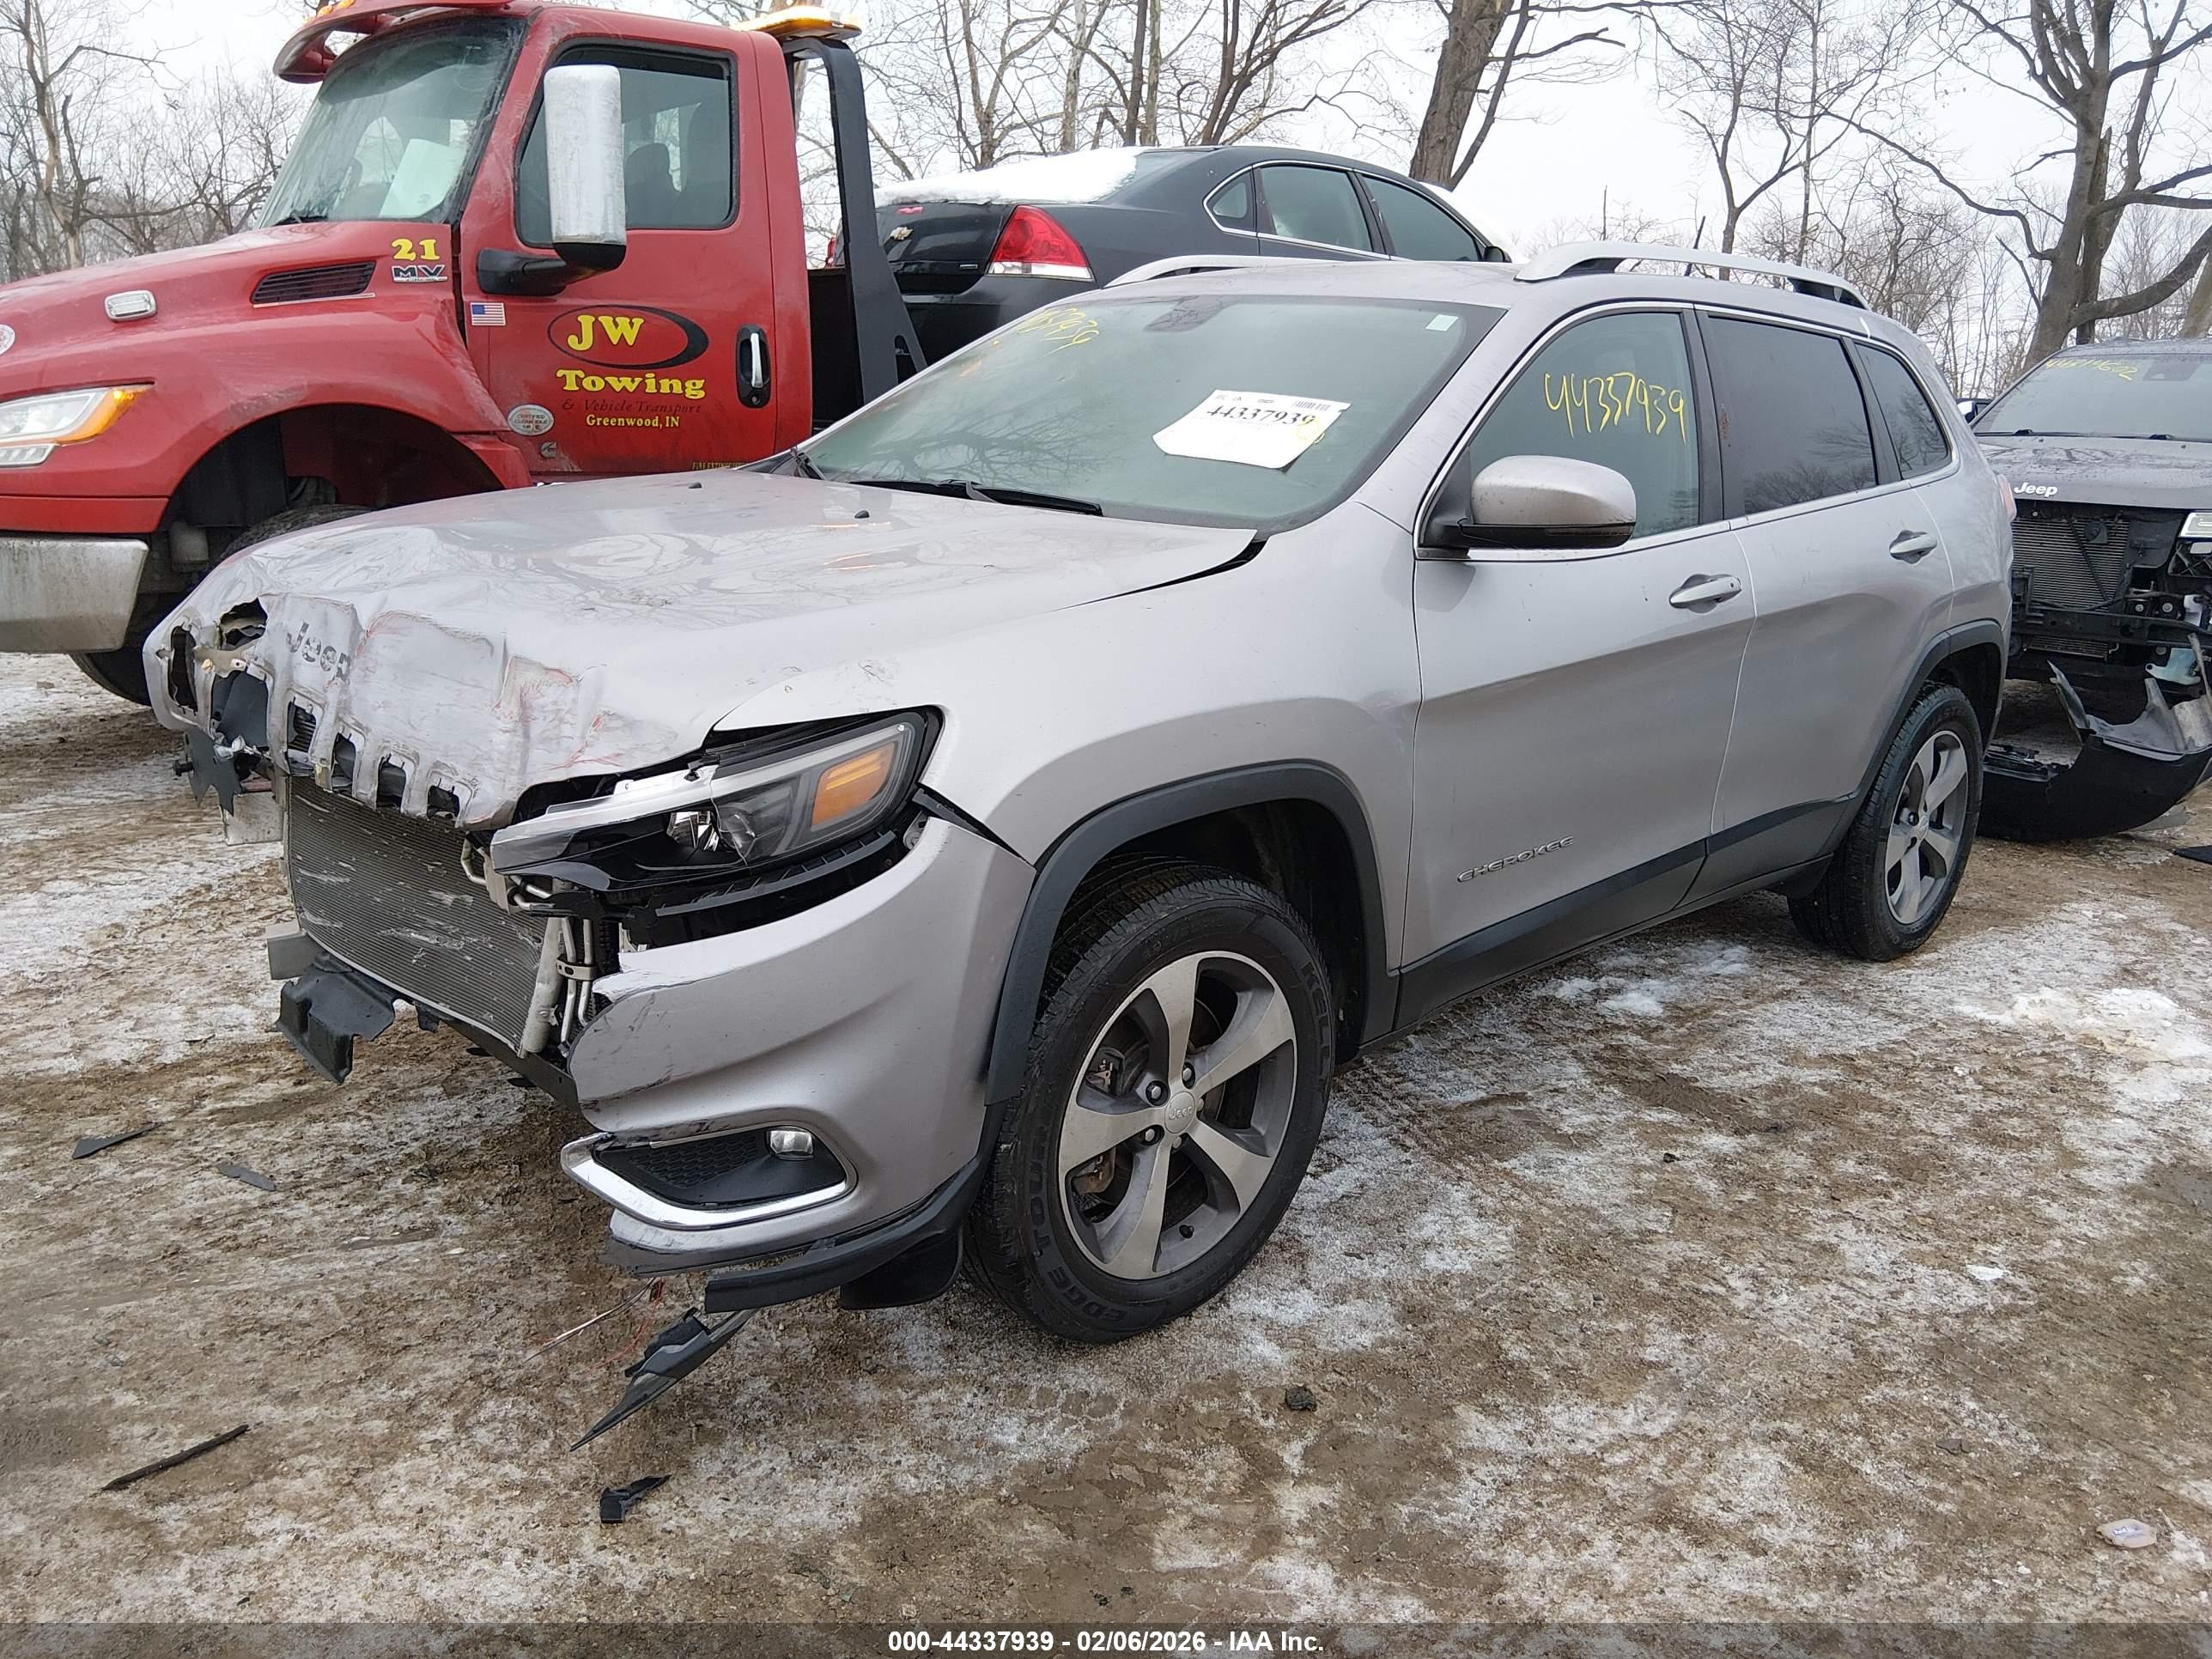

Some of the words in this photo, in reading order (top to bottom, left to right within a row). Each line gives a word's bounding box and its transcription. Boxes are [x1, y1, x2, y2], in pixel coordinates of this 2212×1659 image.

[392, 238, 440, 261] 21
[392, 264, 446, 277] MV
[567, 314, 645, 351] JW
[556, 369, 706, 399] Towing
[562, 398, 574, 410] &
[585, 399, 633, 413] Vehicle
[635, 400, 702, 416] Transport
[1206, 405, 1316, 426] 44337939
[1544, 371, 1686, 445] 44337939
[586, 414, 663, 429] Greenwood,
[665, 416, 679, 427] IN
[2014, 482, 2058, 498] Jeep
[286, 622, 352, 683] Jeep
[1456, 835, 1573, 882] CHEROKEE
[1168, 1105, 1194, 1120] Jeep
